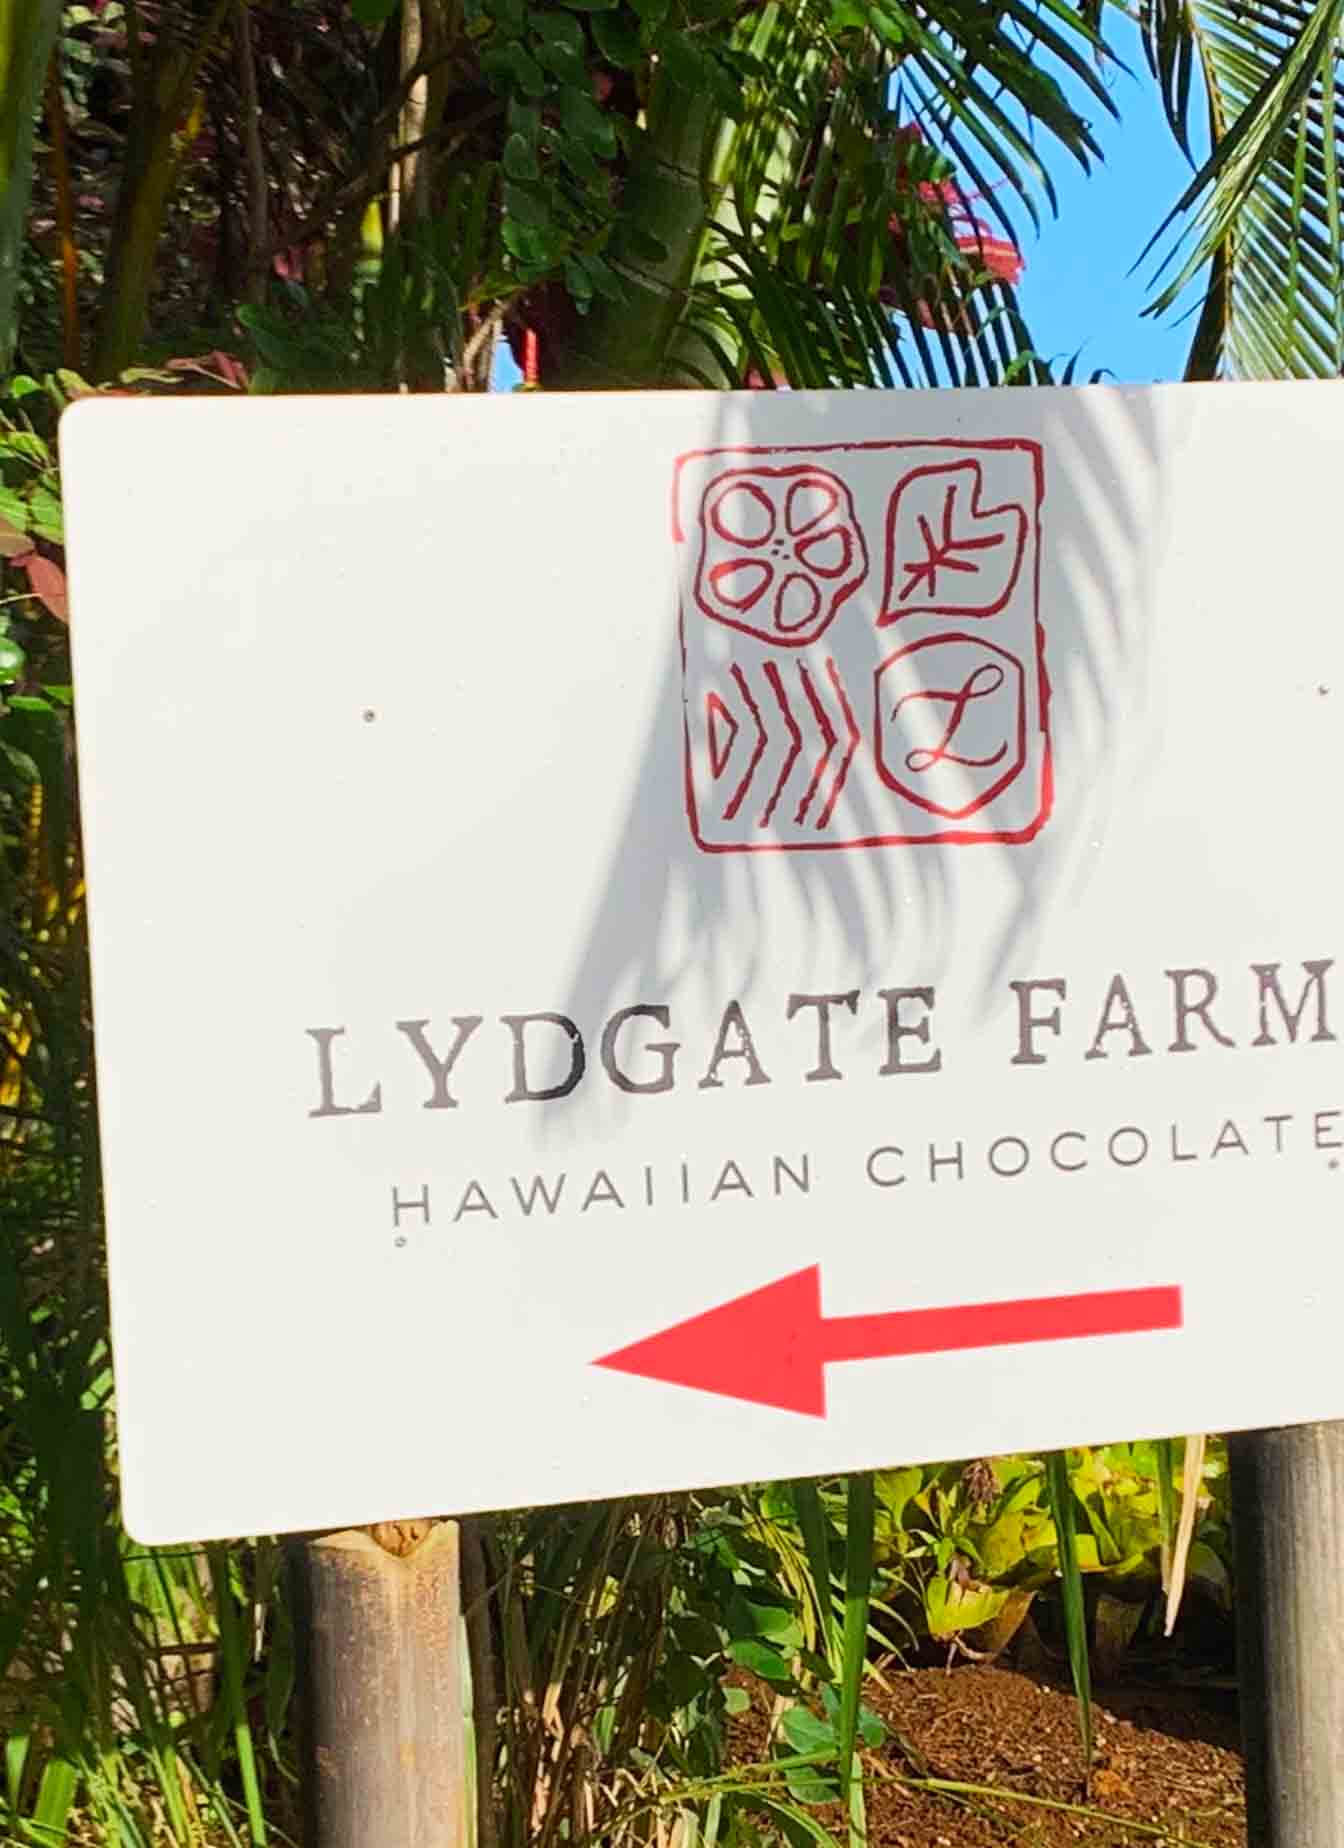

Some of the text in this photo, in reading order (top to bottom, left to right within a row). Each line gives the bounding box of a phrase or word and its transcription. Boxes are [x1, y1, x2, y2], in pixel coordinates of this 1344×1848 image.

[891, 664, 1008, 771] L
[307, 987, 942, 1118] LYDGATE
[392, 1111, 1343, 1227] HAWAIIAN CHOCOLATE
